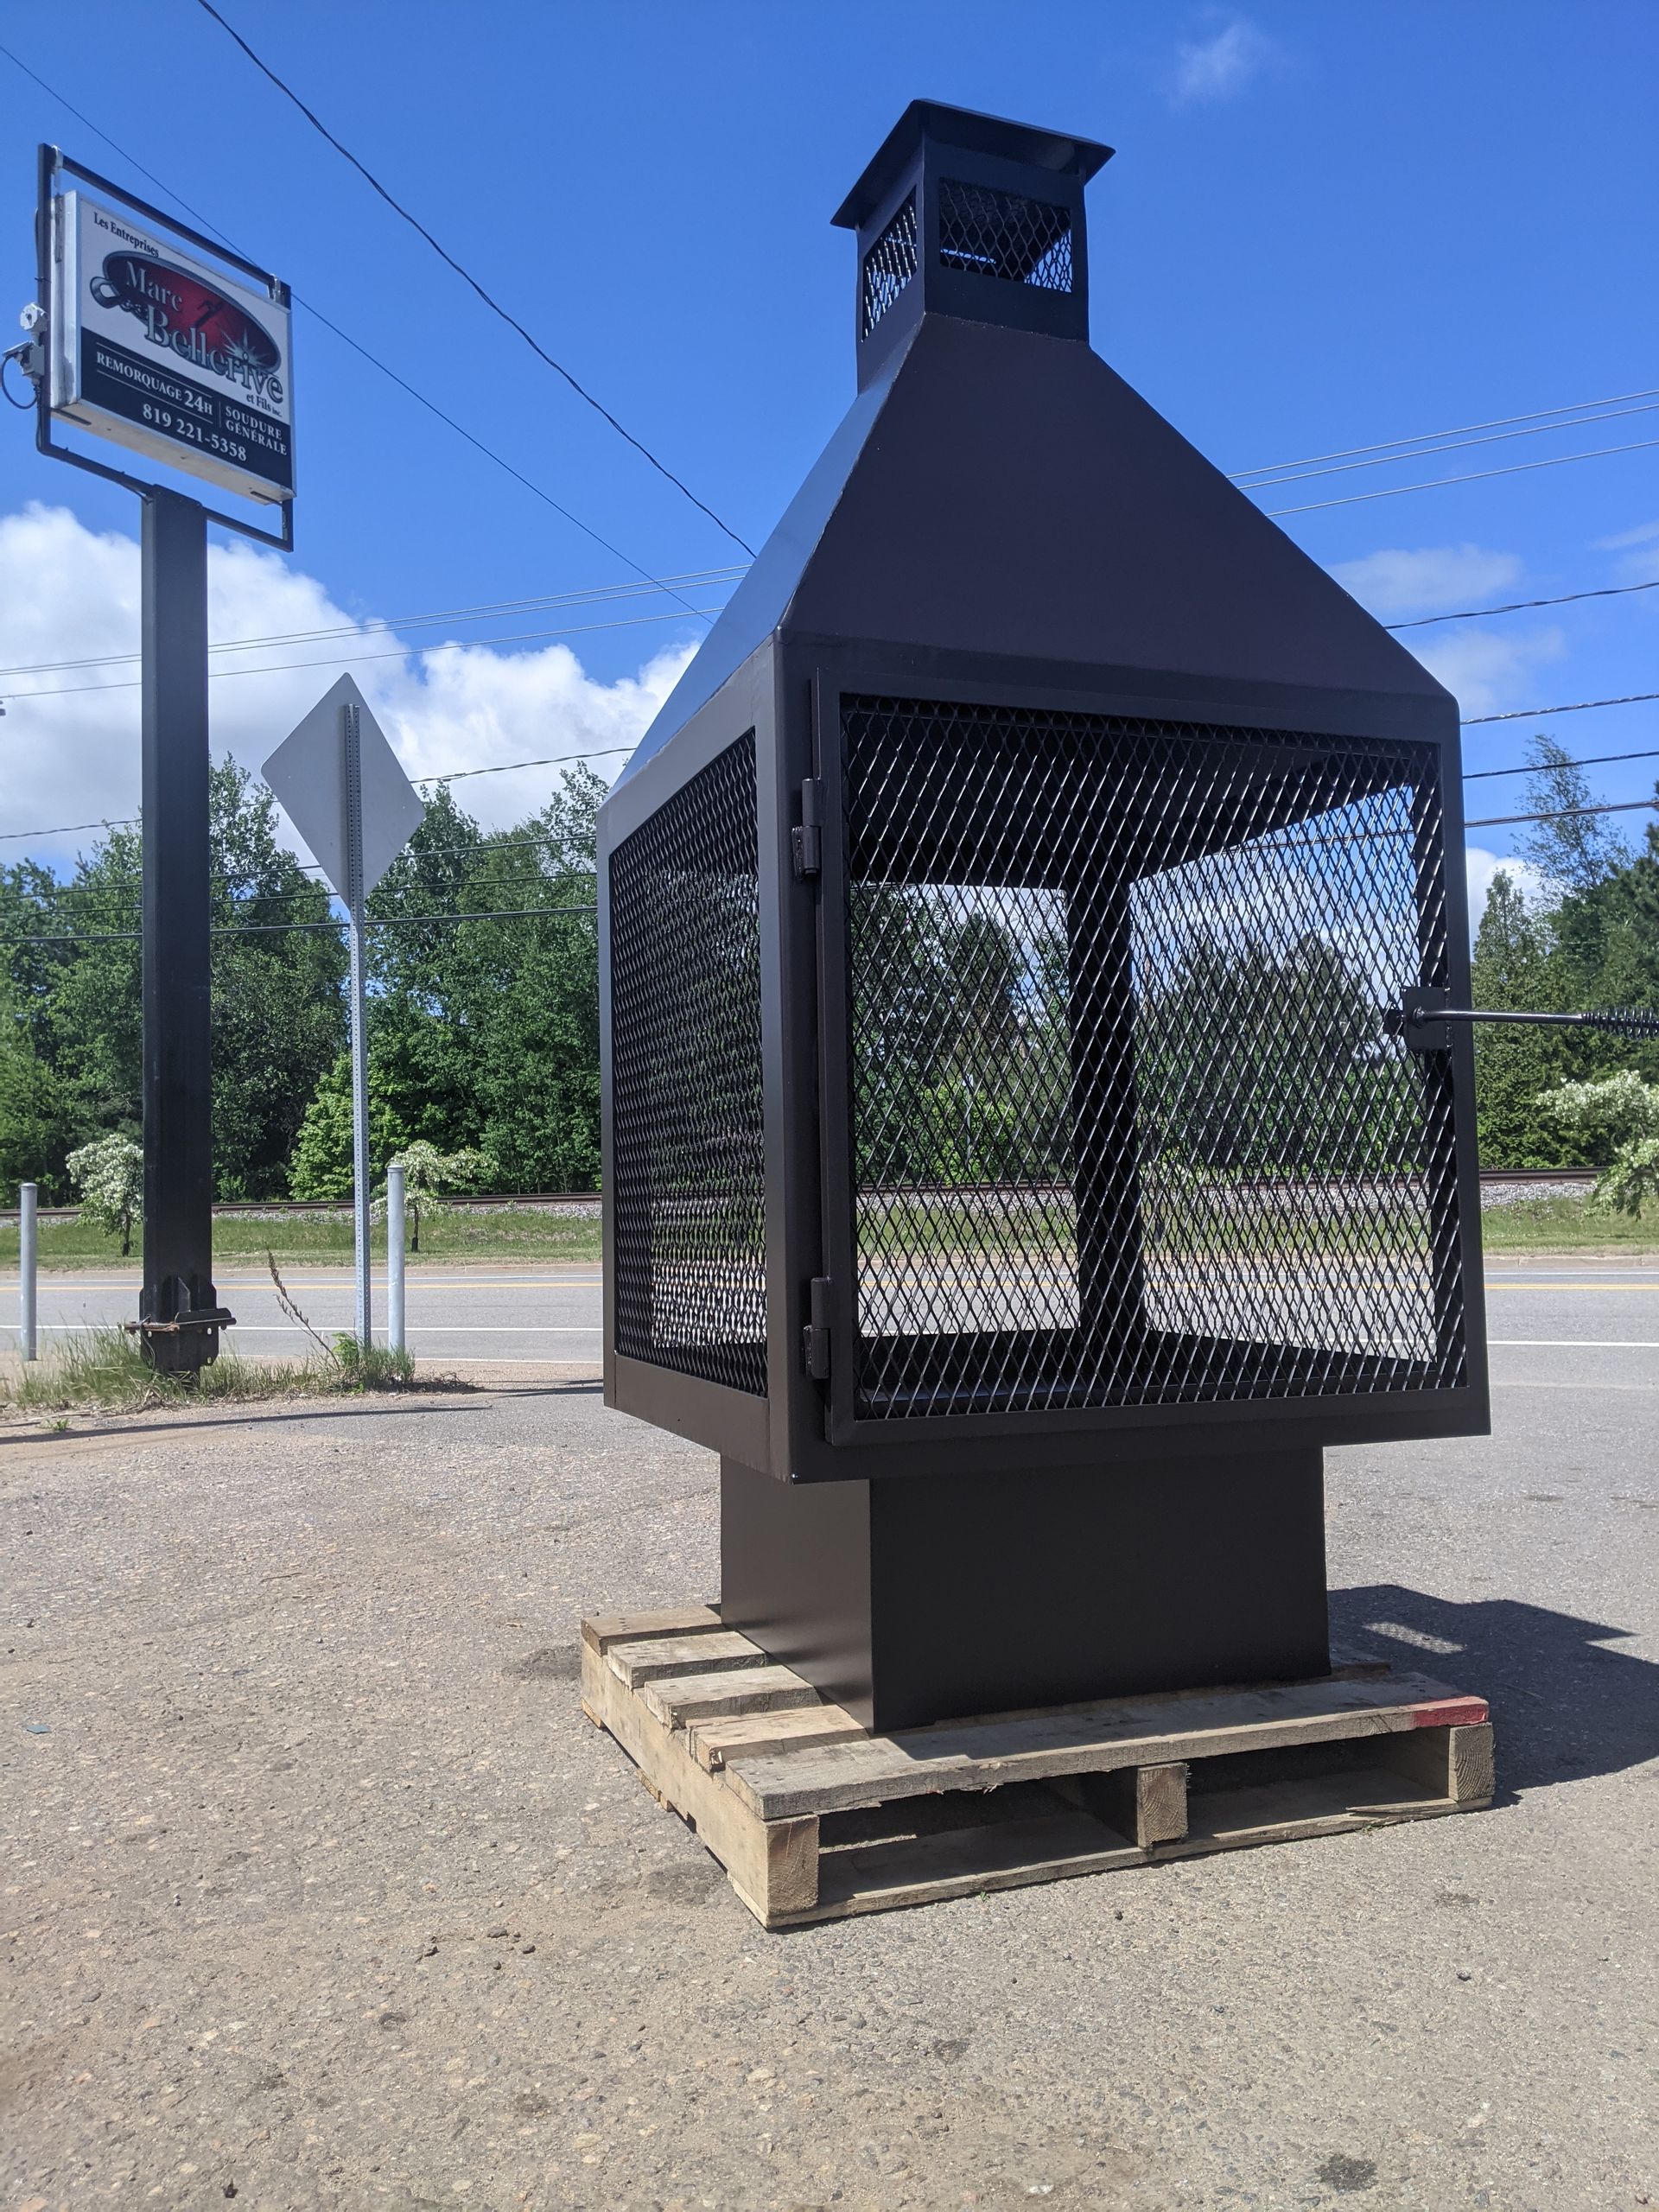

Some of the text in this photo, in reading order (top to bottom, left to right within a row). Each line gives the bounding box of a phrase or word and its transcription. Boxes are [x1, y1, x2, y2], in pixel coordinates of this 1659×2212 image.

[93, 212, 160, 257] Les Entreprises
[126, 261, 183, 312] Marc
[96, 351, 182, 401] REMORQUAGE
[144, 304, 283, 404] Bellerive
[226, 405, 283, 441] SOUDURE
[246, 393, 256, 404] et
[256, 397, 271, 410] Fils
[143, 404, 247, 462] 819 221-5358
[226, 419, 287, 456] GÉNÉRALE
